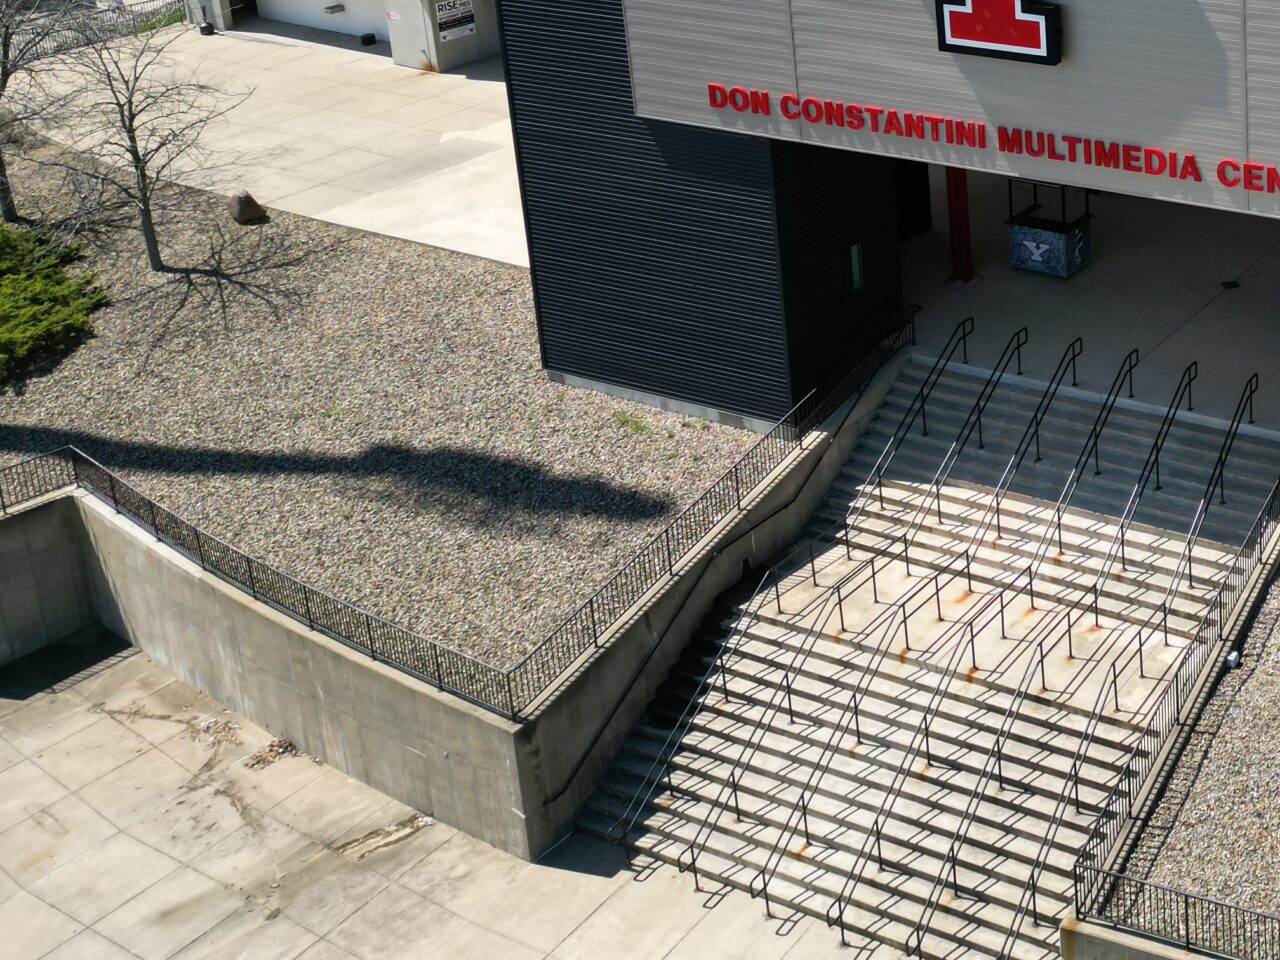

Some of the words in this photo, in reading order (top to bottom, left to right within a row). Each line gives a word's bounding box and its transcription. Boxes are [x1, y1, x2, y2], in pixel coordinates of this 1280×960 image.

[438, 0, 458, 14] RISE
[708, 82, 770, 116] DON
[779, 92, 986, 149] CONSTANTINI
[997, 127, 1201, 182] MULTIMEDIA
[1021, 239, 1050, 262] Y
